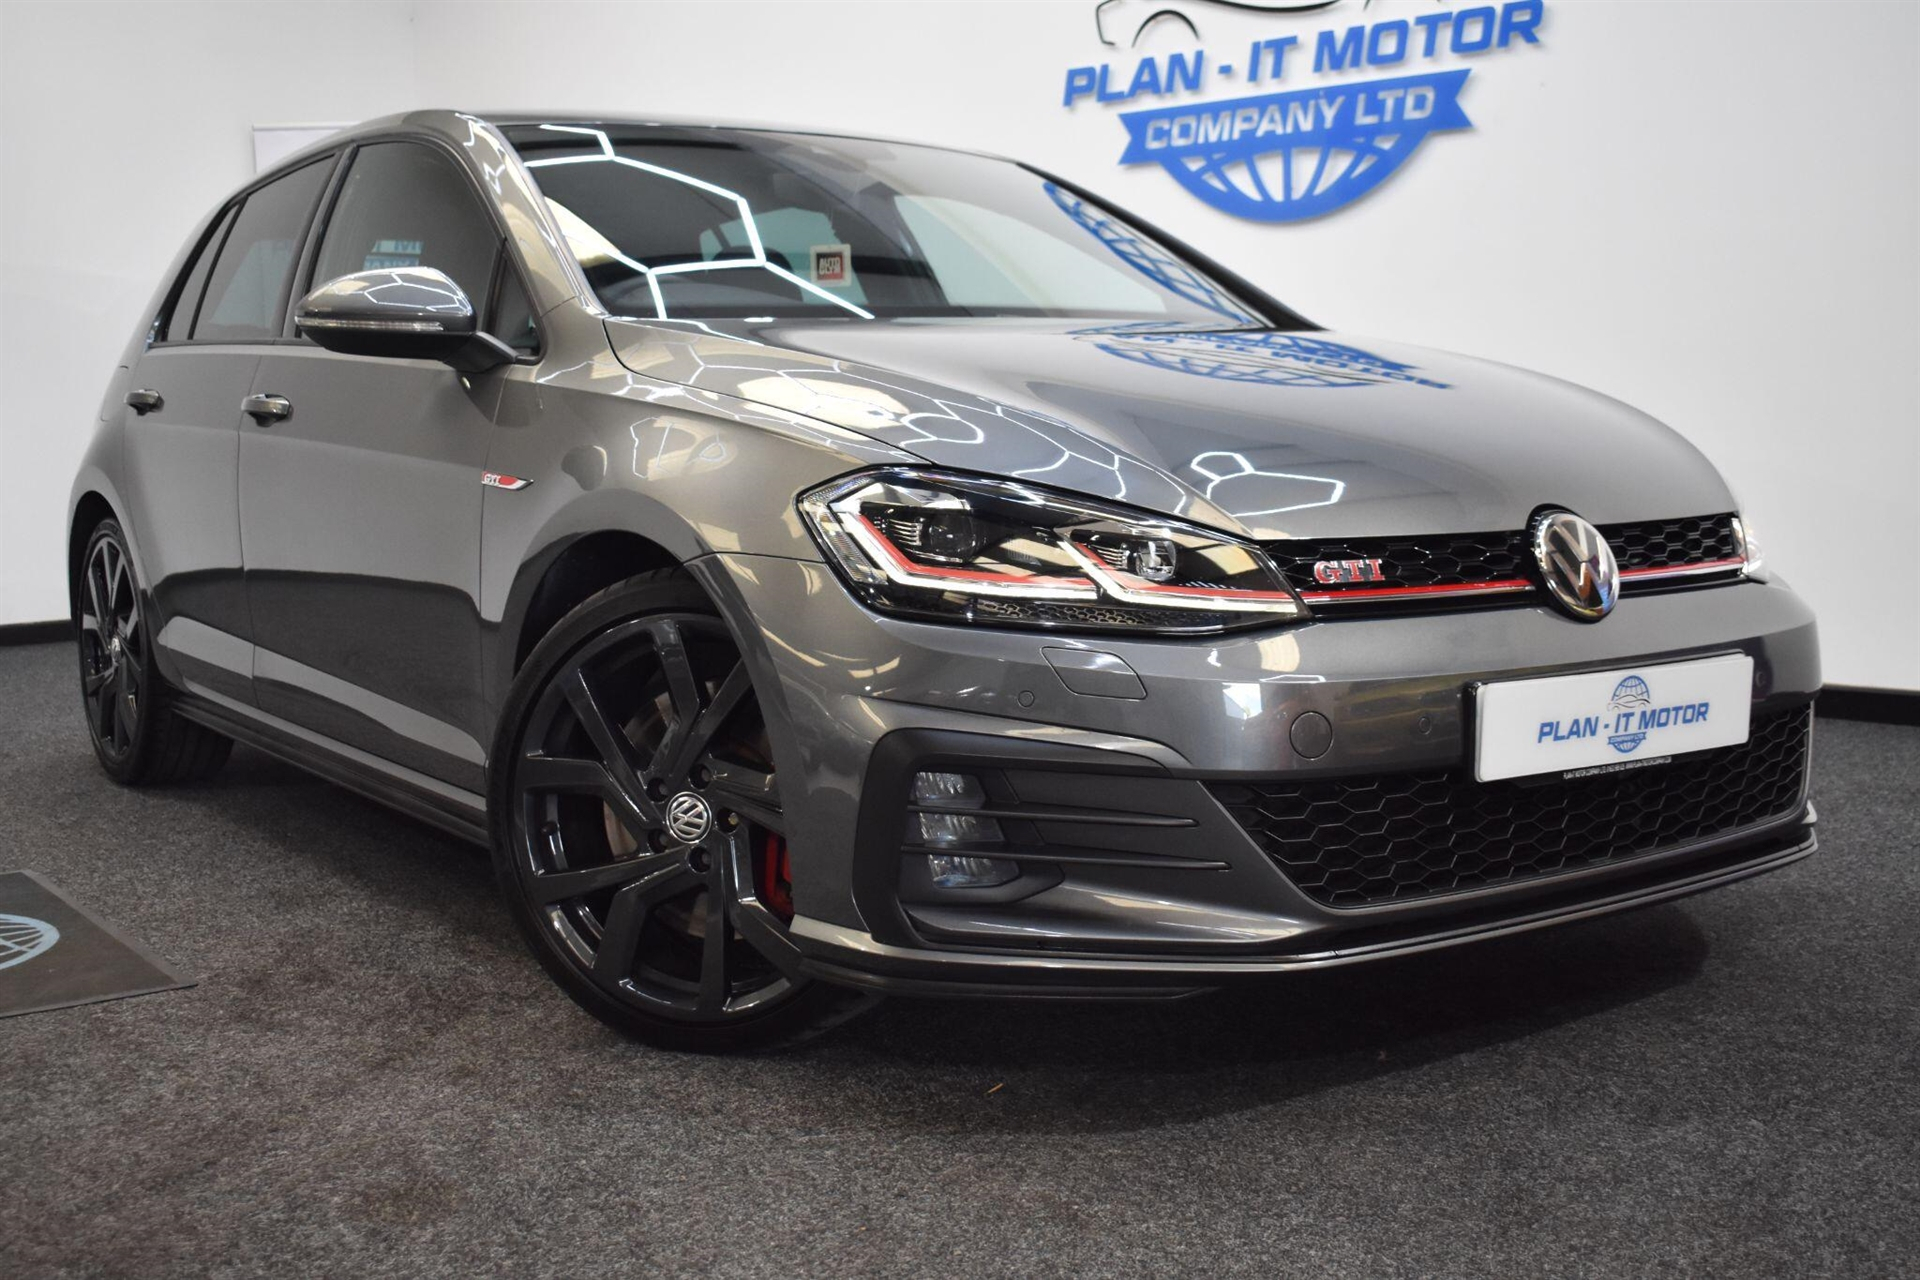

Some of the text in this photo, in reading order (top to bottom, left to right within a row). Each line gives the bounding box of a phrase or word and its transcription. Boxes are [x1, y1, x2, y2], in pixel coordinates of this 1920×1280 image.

[1063, 50, 1205, 106] PLAN
[1247, 36, 1299, 82] IT
[1312, 0, 1544, 74] MOTOR
[1145, 85, 1436, 150] COMPANY LTD
[1313, 558, 1386, 584] GTI
[1537, 716, 1599, 743] PLAN
[1614, 712, 1635, 733] IT
[1639, 702, 1710, 730] MOTOR
